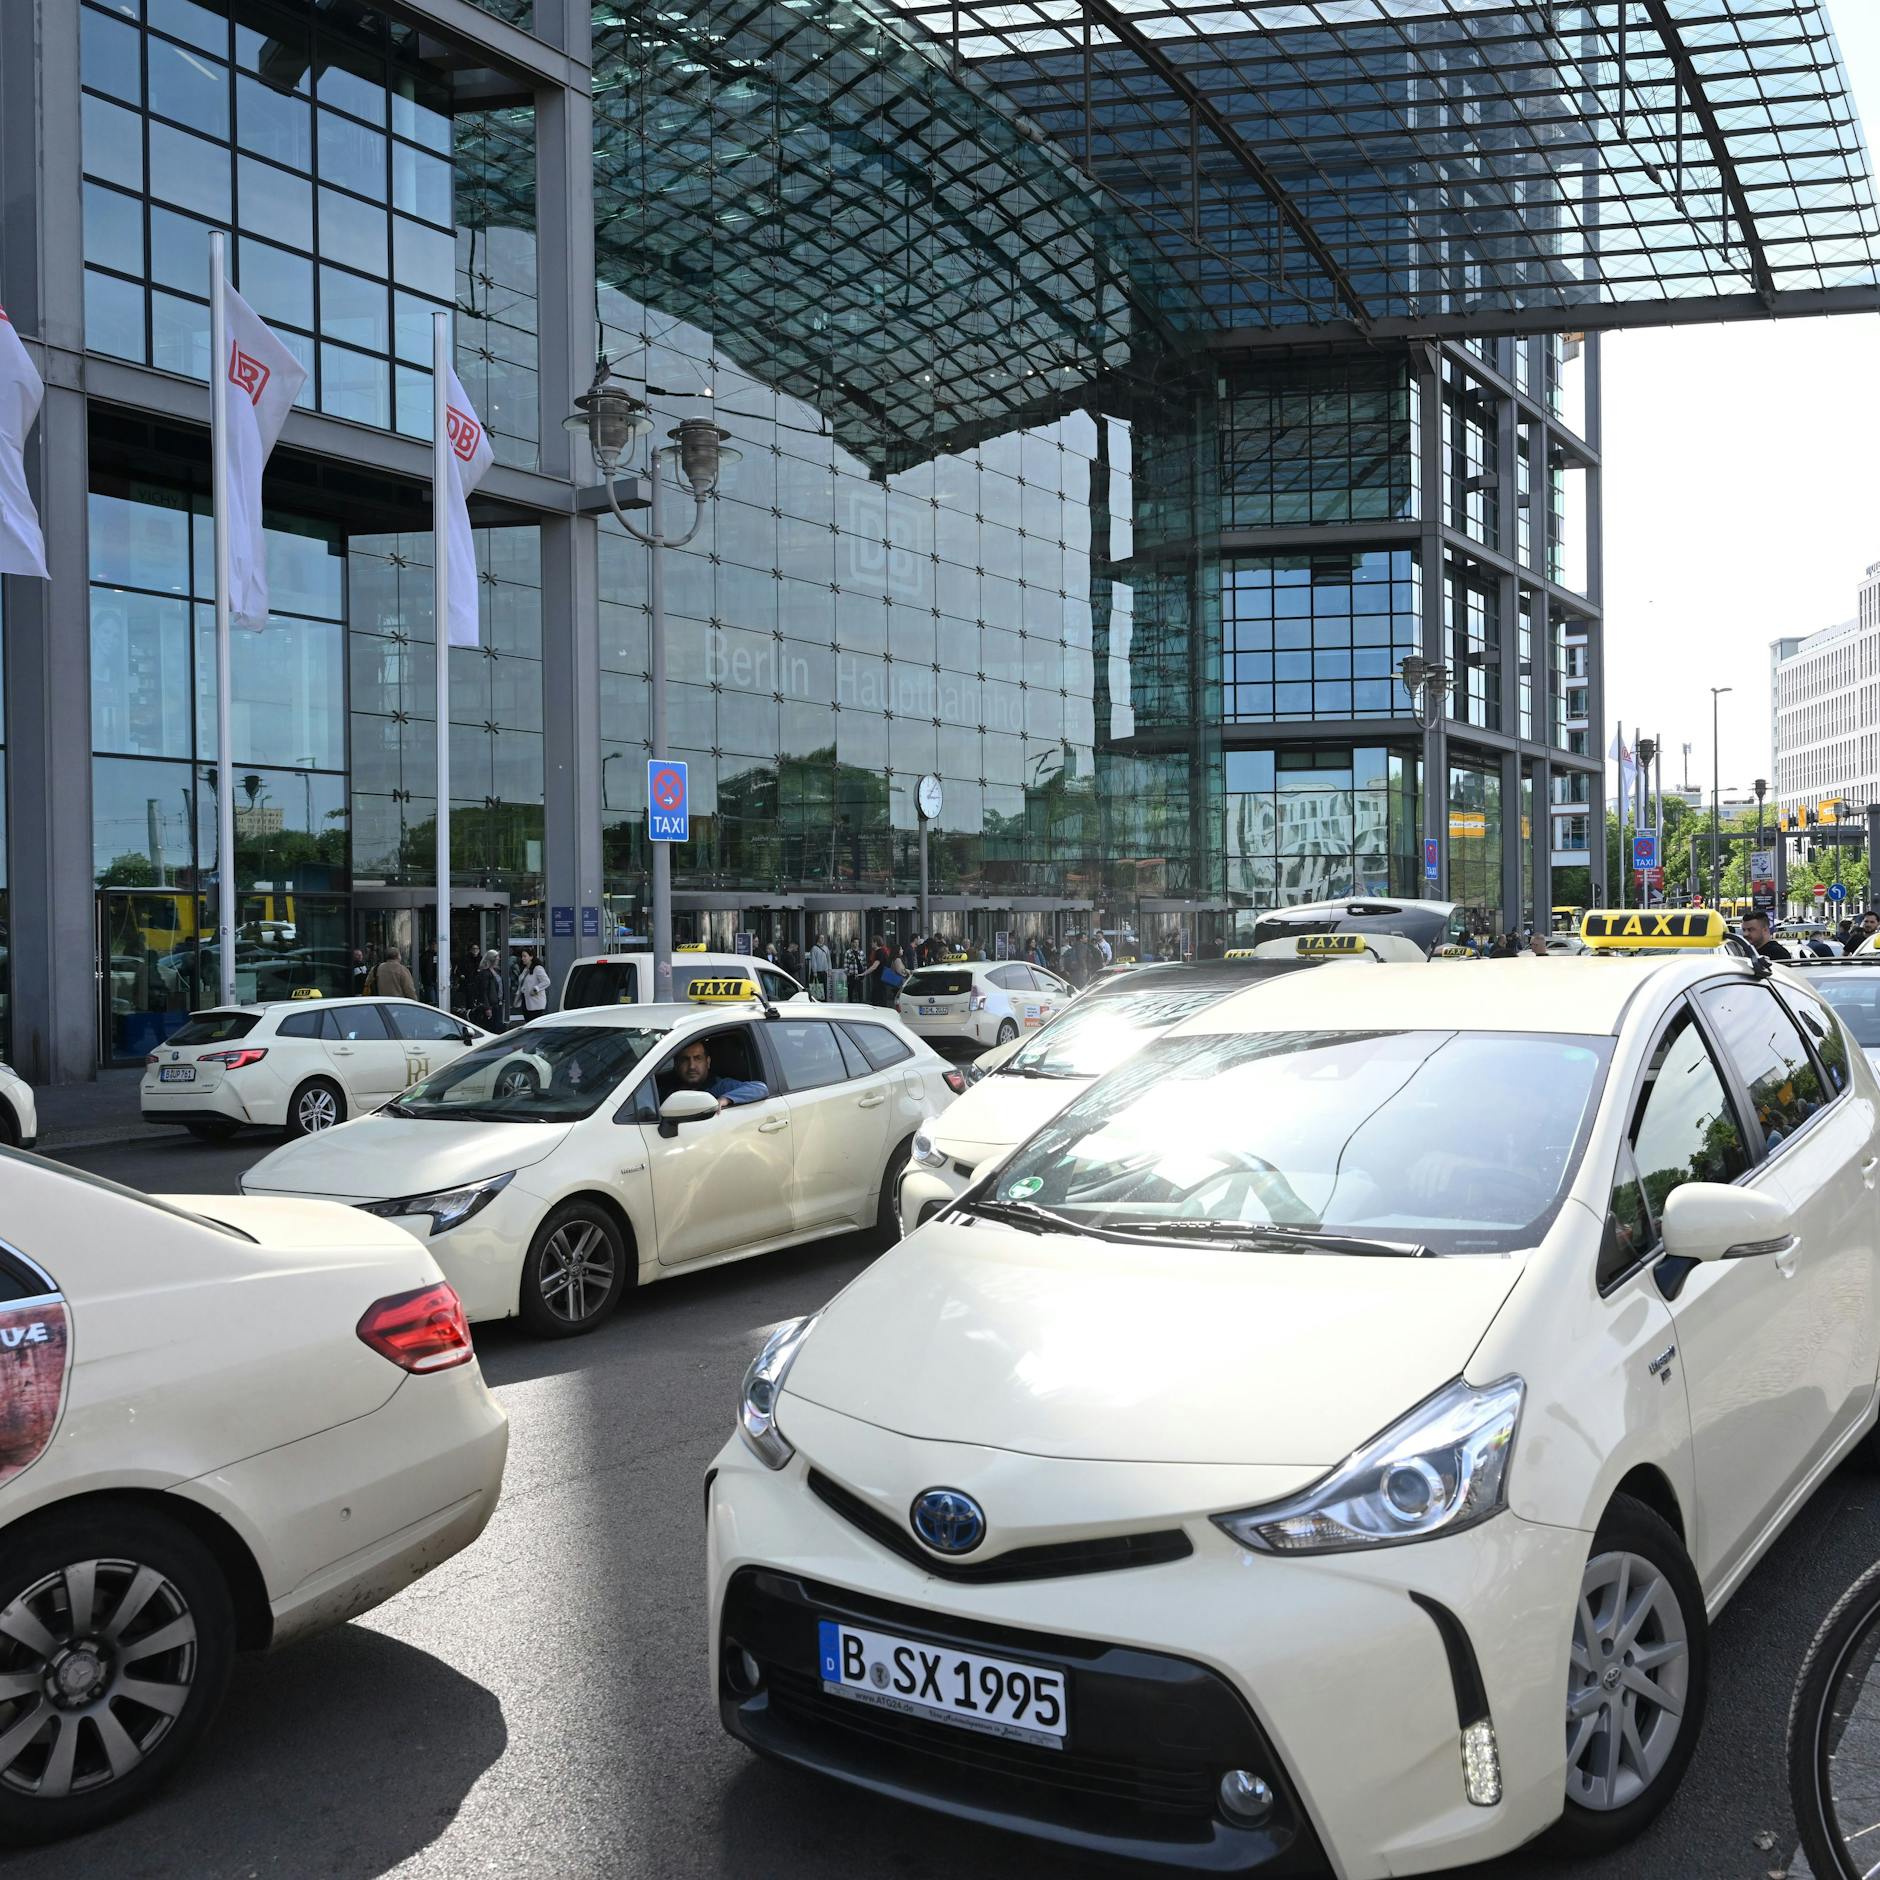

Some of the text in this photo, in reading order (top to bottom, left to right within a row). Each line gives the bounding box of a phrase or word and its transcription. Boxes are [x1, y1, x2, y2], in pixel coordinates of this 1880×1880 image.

[138, 489, 178, 505] VICHY
[859, 504, 916, 579] DB
[704, 629, 1032, 729] Berlin Hauptbahnhof
[653, 816, 684, 834] TAXI
[1635, 859, 1654, 867] TAXI
[1602, 914, 1692, 935] TAXI
[1306, 937, 1349, 948] TAXI
[696, 982, 736, 995] TAXI
[826, 1657, 835, 1672] D
[843, 1633, 1060, 1726] B SX 1995
